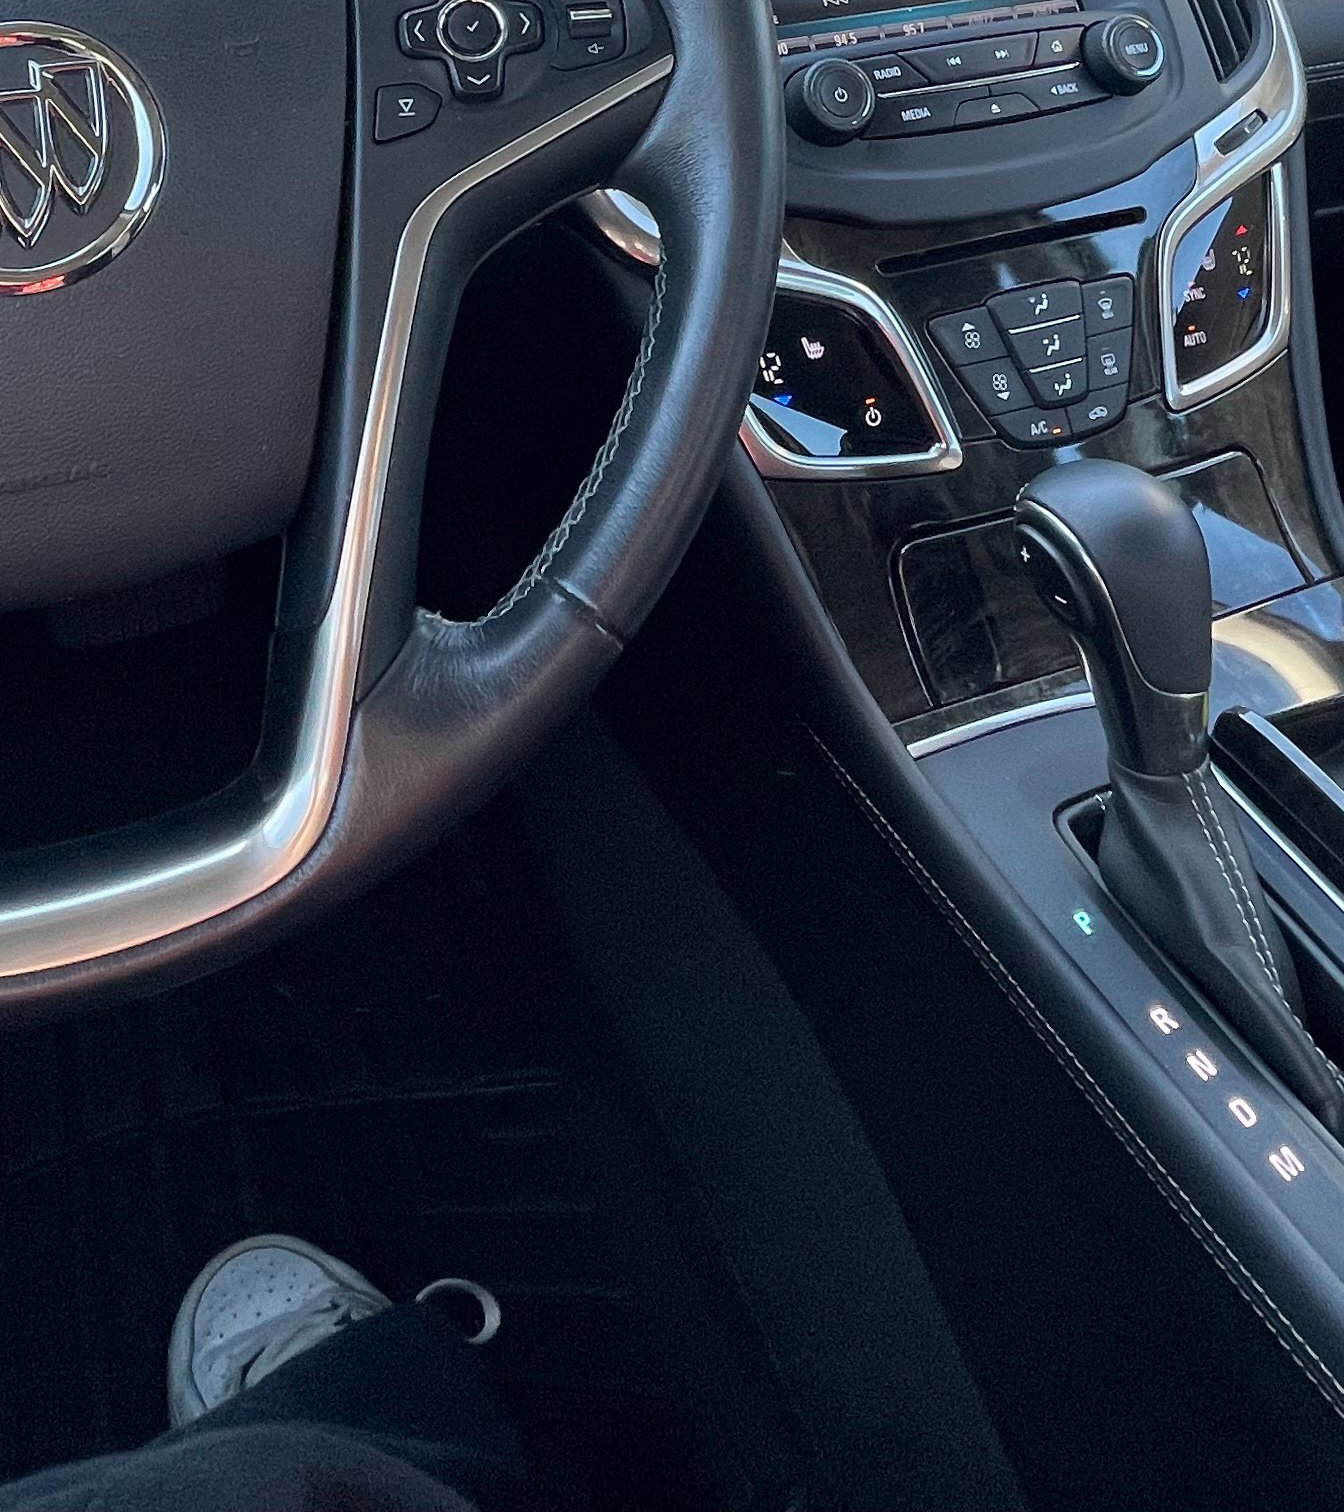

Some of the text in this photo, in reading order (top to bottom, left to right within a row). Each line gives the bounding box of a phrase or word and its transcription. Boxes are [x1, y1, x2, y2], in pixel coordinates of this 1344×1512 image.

[1125, 42, 1149, 56] MENU
[874, 65, 901, 81] RADIO
[1057, 82, 1078, 95] BACK
[901, 106, 932, 123] MEDIA
[1183, 287, 1206, 303] SYNC
[1184, 331, 1207, 348] AUTO
[1030, 420, 1049, 437] A/C
[1073, 910, 1094, 936] P
[1149, 1006, 1180, 1036] R
[1185, 1050, 1219, 1082] N
[1227, 1097, 1257, 1129] D
[1268, 1144, 1306, 1183] M
